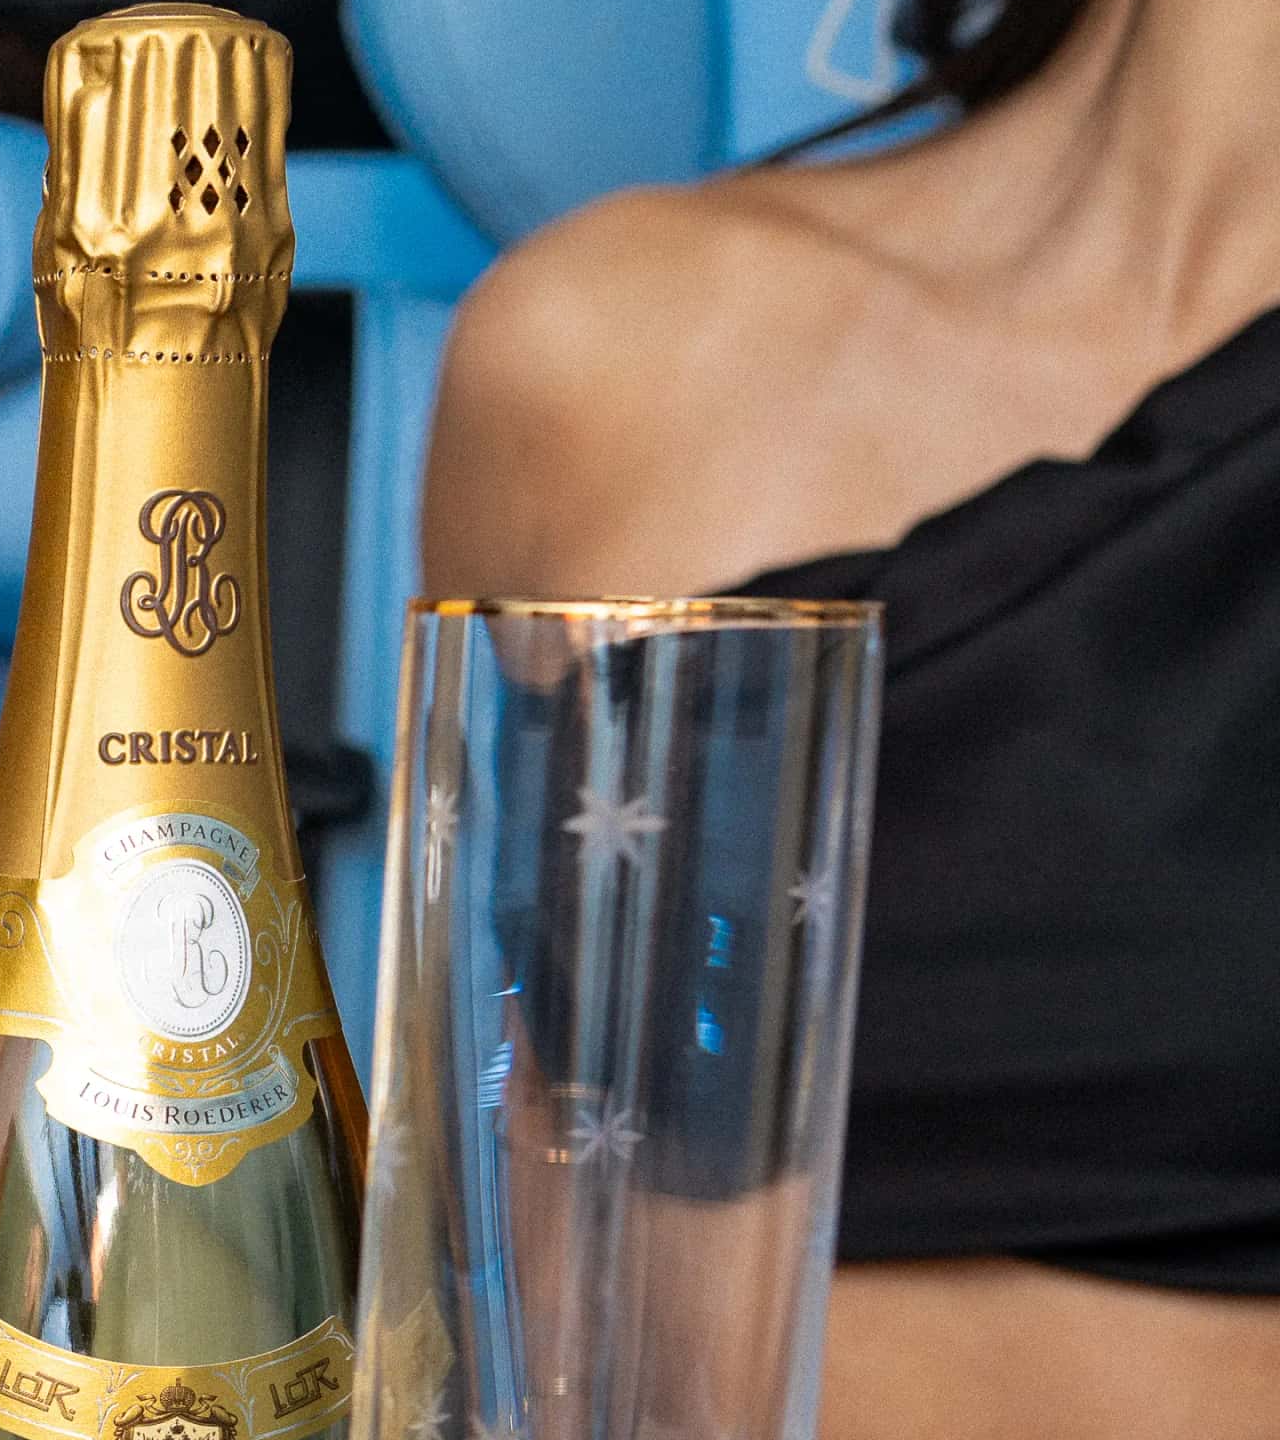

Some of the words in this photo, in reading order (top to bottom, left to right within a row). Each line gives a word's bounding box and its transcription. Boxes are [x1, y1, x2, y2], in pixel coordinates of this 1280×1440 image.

[97, 729, 258, 766] CRISTAL
[103, 820, 254, 864] CHAMPAGNE
[79, 1080, 154, 1124] LOUIS
[164, 1082, 290, 1127] ROEDERER
